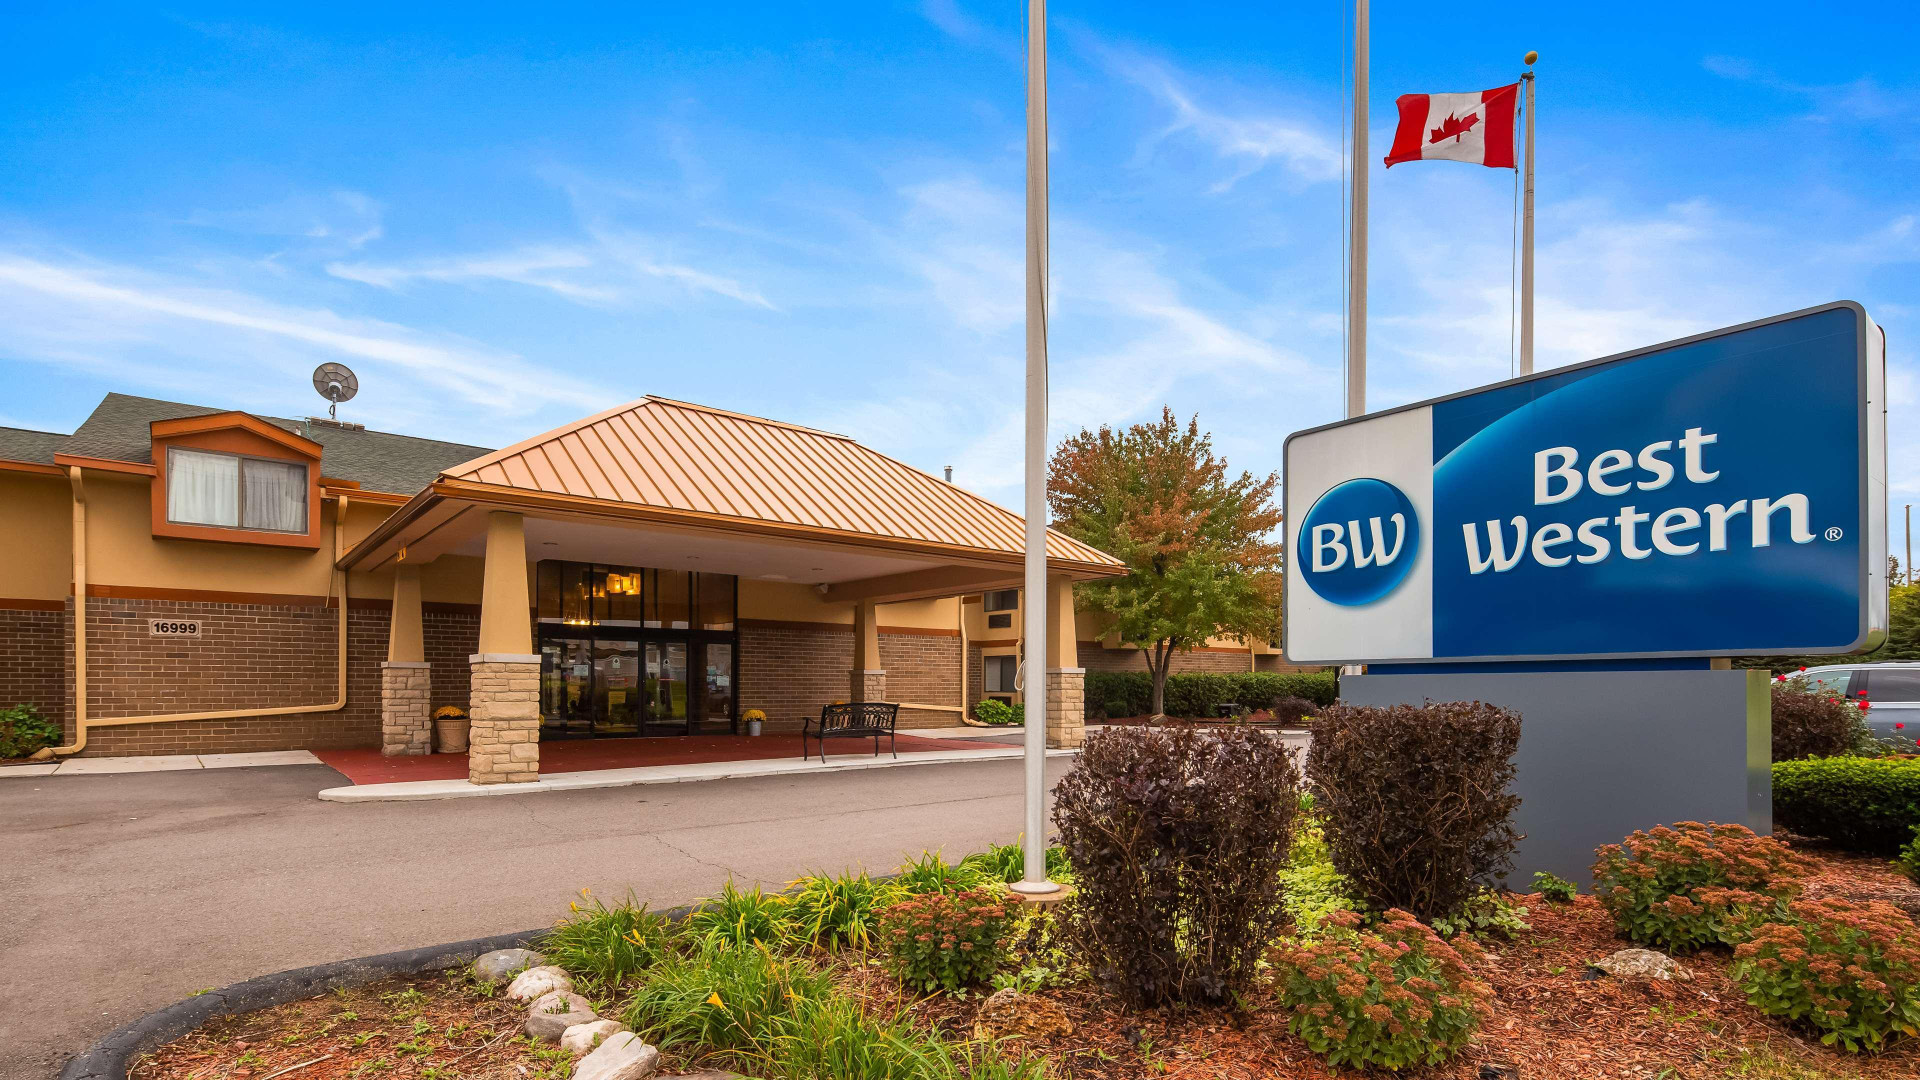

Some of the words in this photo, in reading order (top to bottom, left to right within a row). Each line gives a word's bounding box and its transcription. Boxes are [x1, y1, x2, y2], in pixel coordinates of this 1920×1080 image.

[1534, 427, 1720, 506] Best
[1312, 513, 1405, 573] BW
[1463, 493, 1817, 574] Western
[154, 622, 197, 634] 16999
